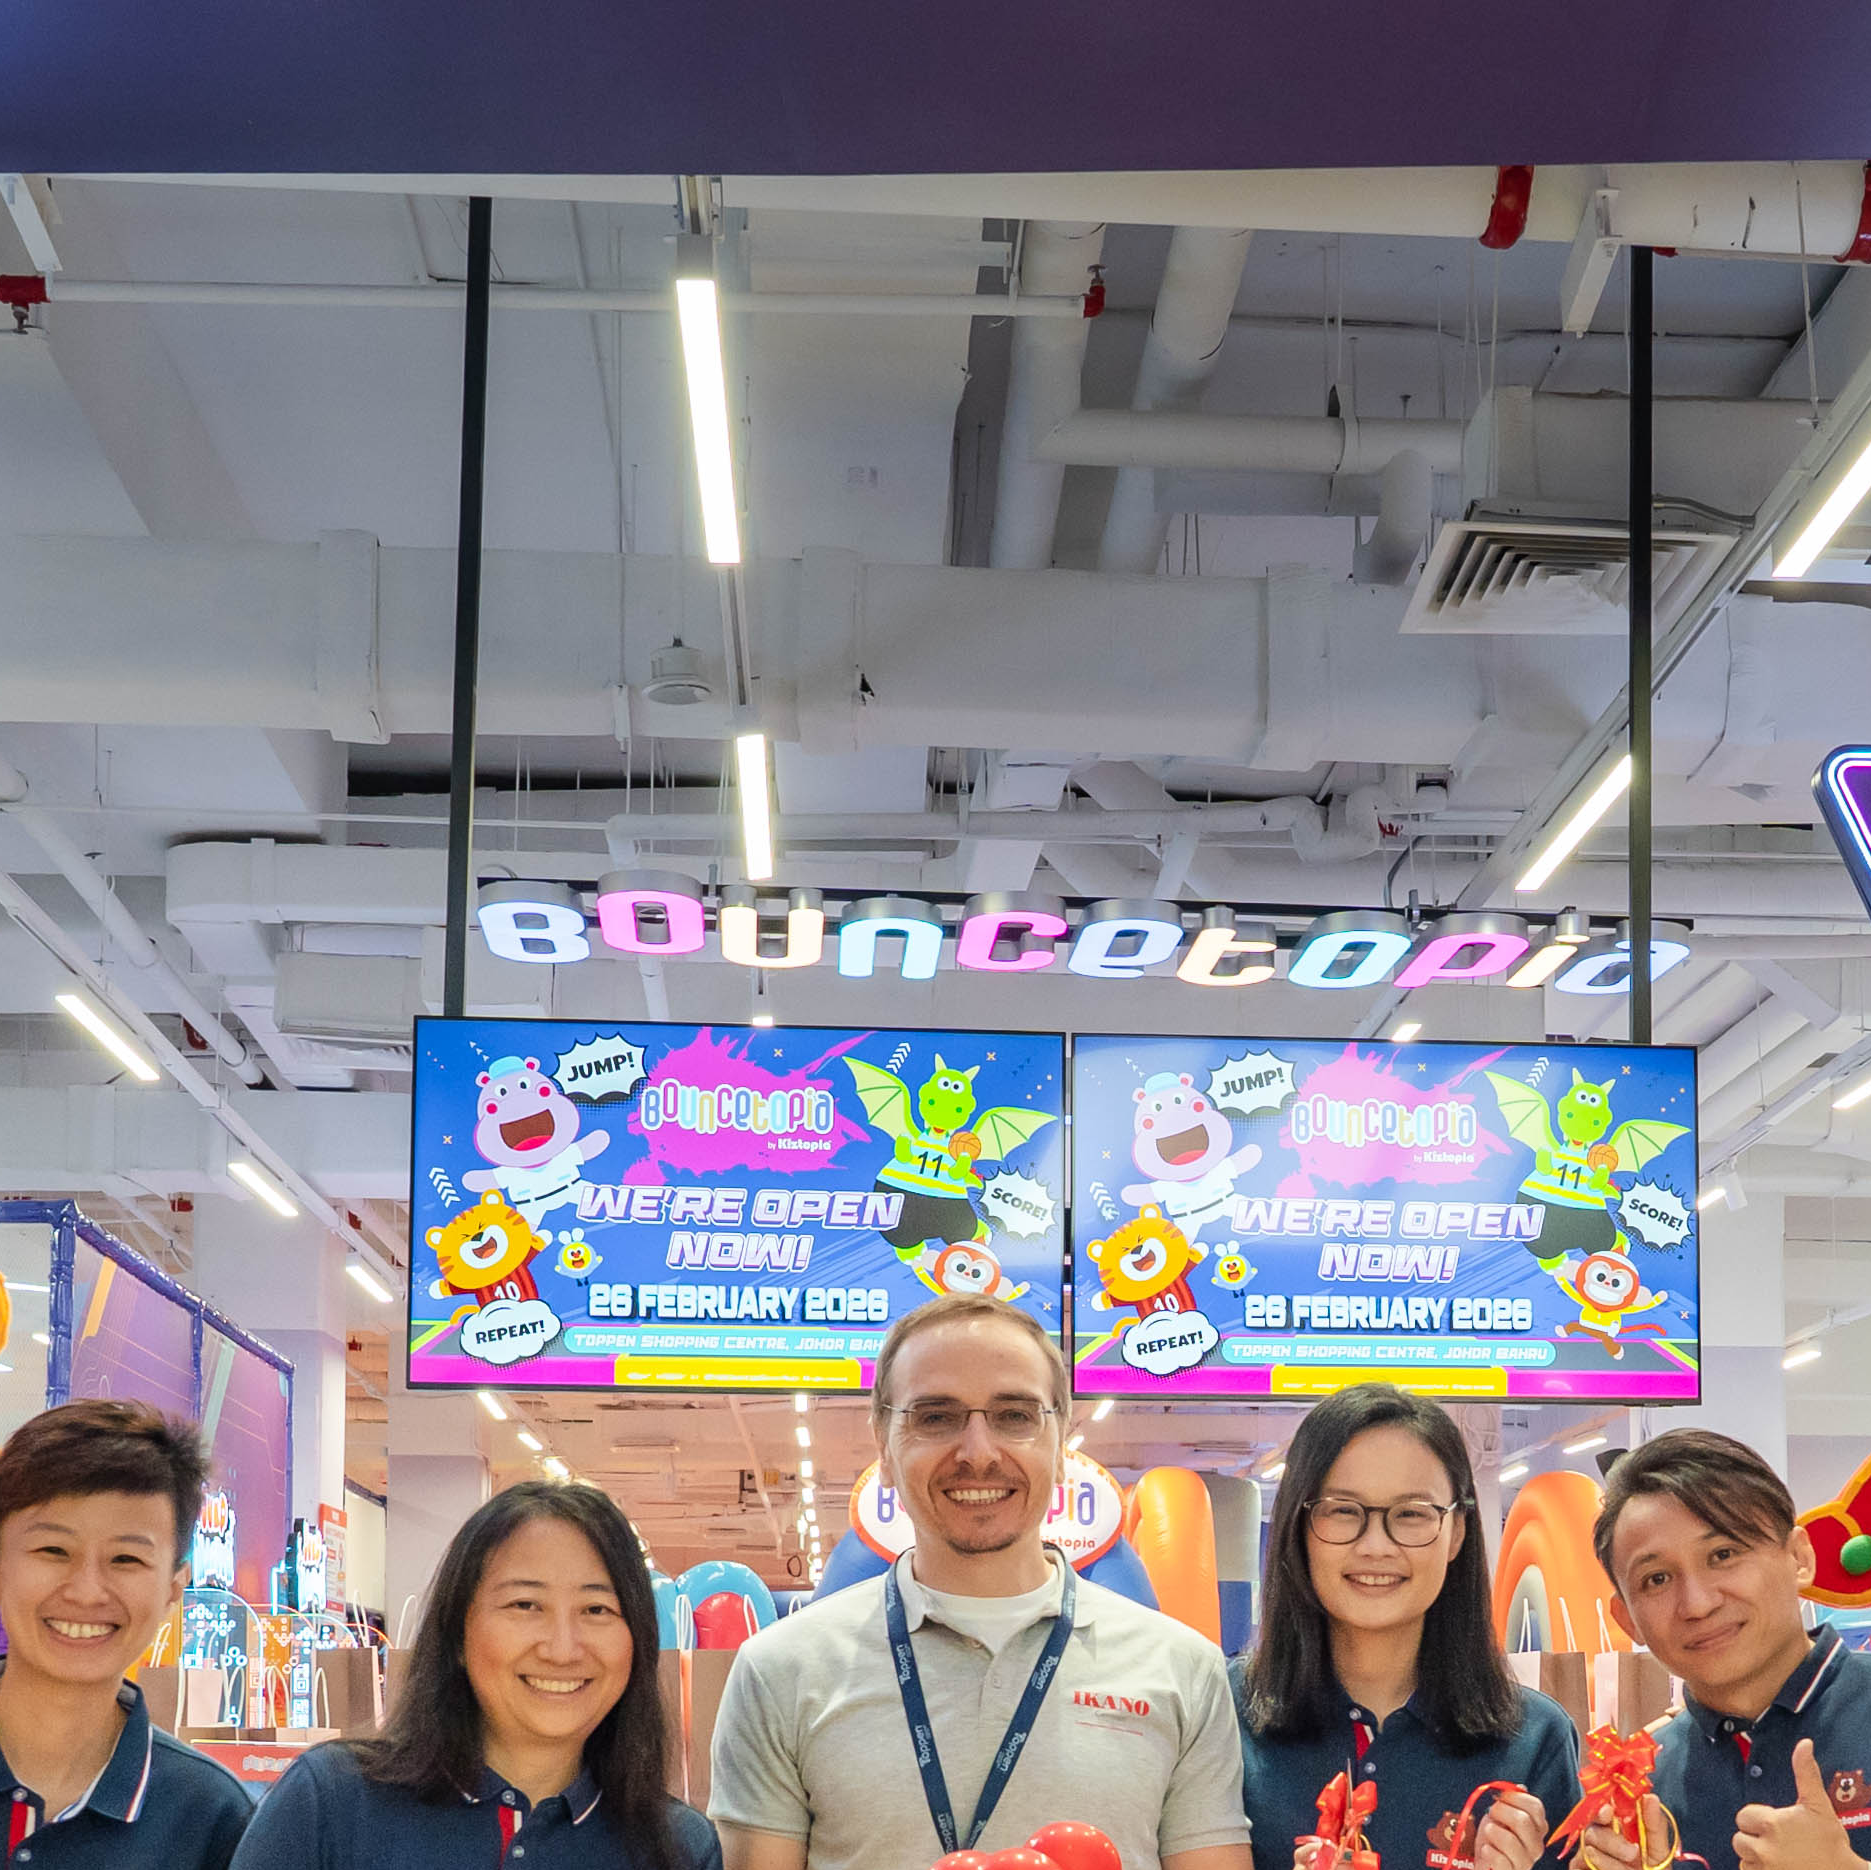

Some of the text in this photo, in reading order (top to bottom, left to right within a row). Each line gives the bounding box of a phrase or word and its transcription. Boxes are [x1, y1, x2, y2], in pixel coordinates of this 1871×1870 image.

[567, 1051, 635, 1083] JUMP!
[1220, 1066, 1284, 1098] JUMP!
[778, 1138, 832, 1153] Kiztopia
[918, 1151, 942, 1179] 11
[1557, 1164, 1581, 1190] 11
[578, 1187, 903, 1230] WE'RE OPEN
[991, 1186, 1048, 1221] SCORE!
[1628, 1196, 1684, 1231] SCORE!
[1234, 1200, 1545, 1241] WE'RE OPEN
[668, 1233, 813, 1271] NOW!
[1318, 1245, 1459, 1283] NOW!
[493, 1281, 521, 1303] 10
[638, 1285, 797, 1321] FEBRUARY
[804, 1288, 888, 1322] 2026
[1153, 1295, 1178, 1312] 10
[1292, 1297, 1447, 1329] FEBRUARY
[1453, 1298, 1532, 1330] 2026
[475, 1321, 546, 1345] REPEAT!
[575, 1334, 636, 1347] TOPPEN
[640, 1335, 720, 1349] SHOPPING
[795, 1337, 845, 1350] JOHOR
[1136, 1331, 1204, 1356] REPEAT!
[1232, 1344, 1291, 1357] TOPPEN
[1295, 1345, 1372, 1358] SHOPPING
[1443, 1347, 1491, 1359] JOHOR
[1495, 1347, 1547, 1360] BAHRU
[896, 1644, 911, 1684] Toppen
[1035, 1655, 1058, 1690] Toppen
[1073, 1690, 1150, 1716] IKANO
[915, 1725, 931, 1768] Toppen
[1000, 1732, 1027, 1773] Toppen
[937, 1813, 953, 1854] oppen
[1430, 1853, 1475, 1870] Kizopia
